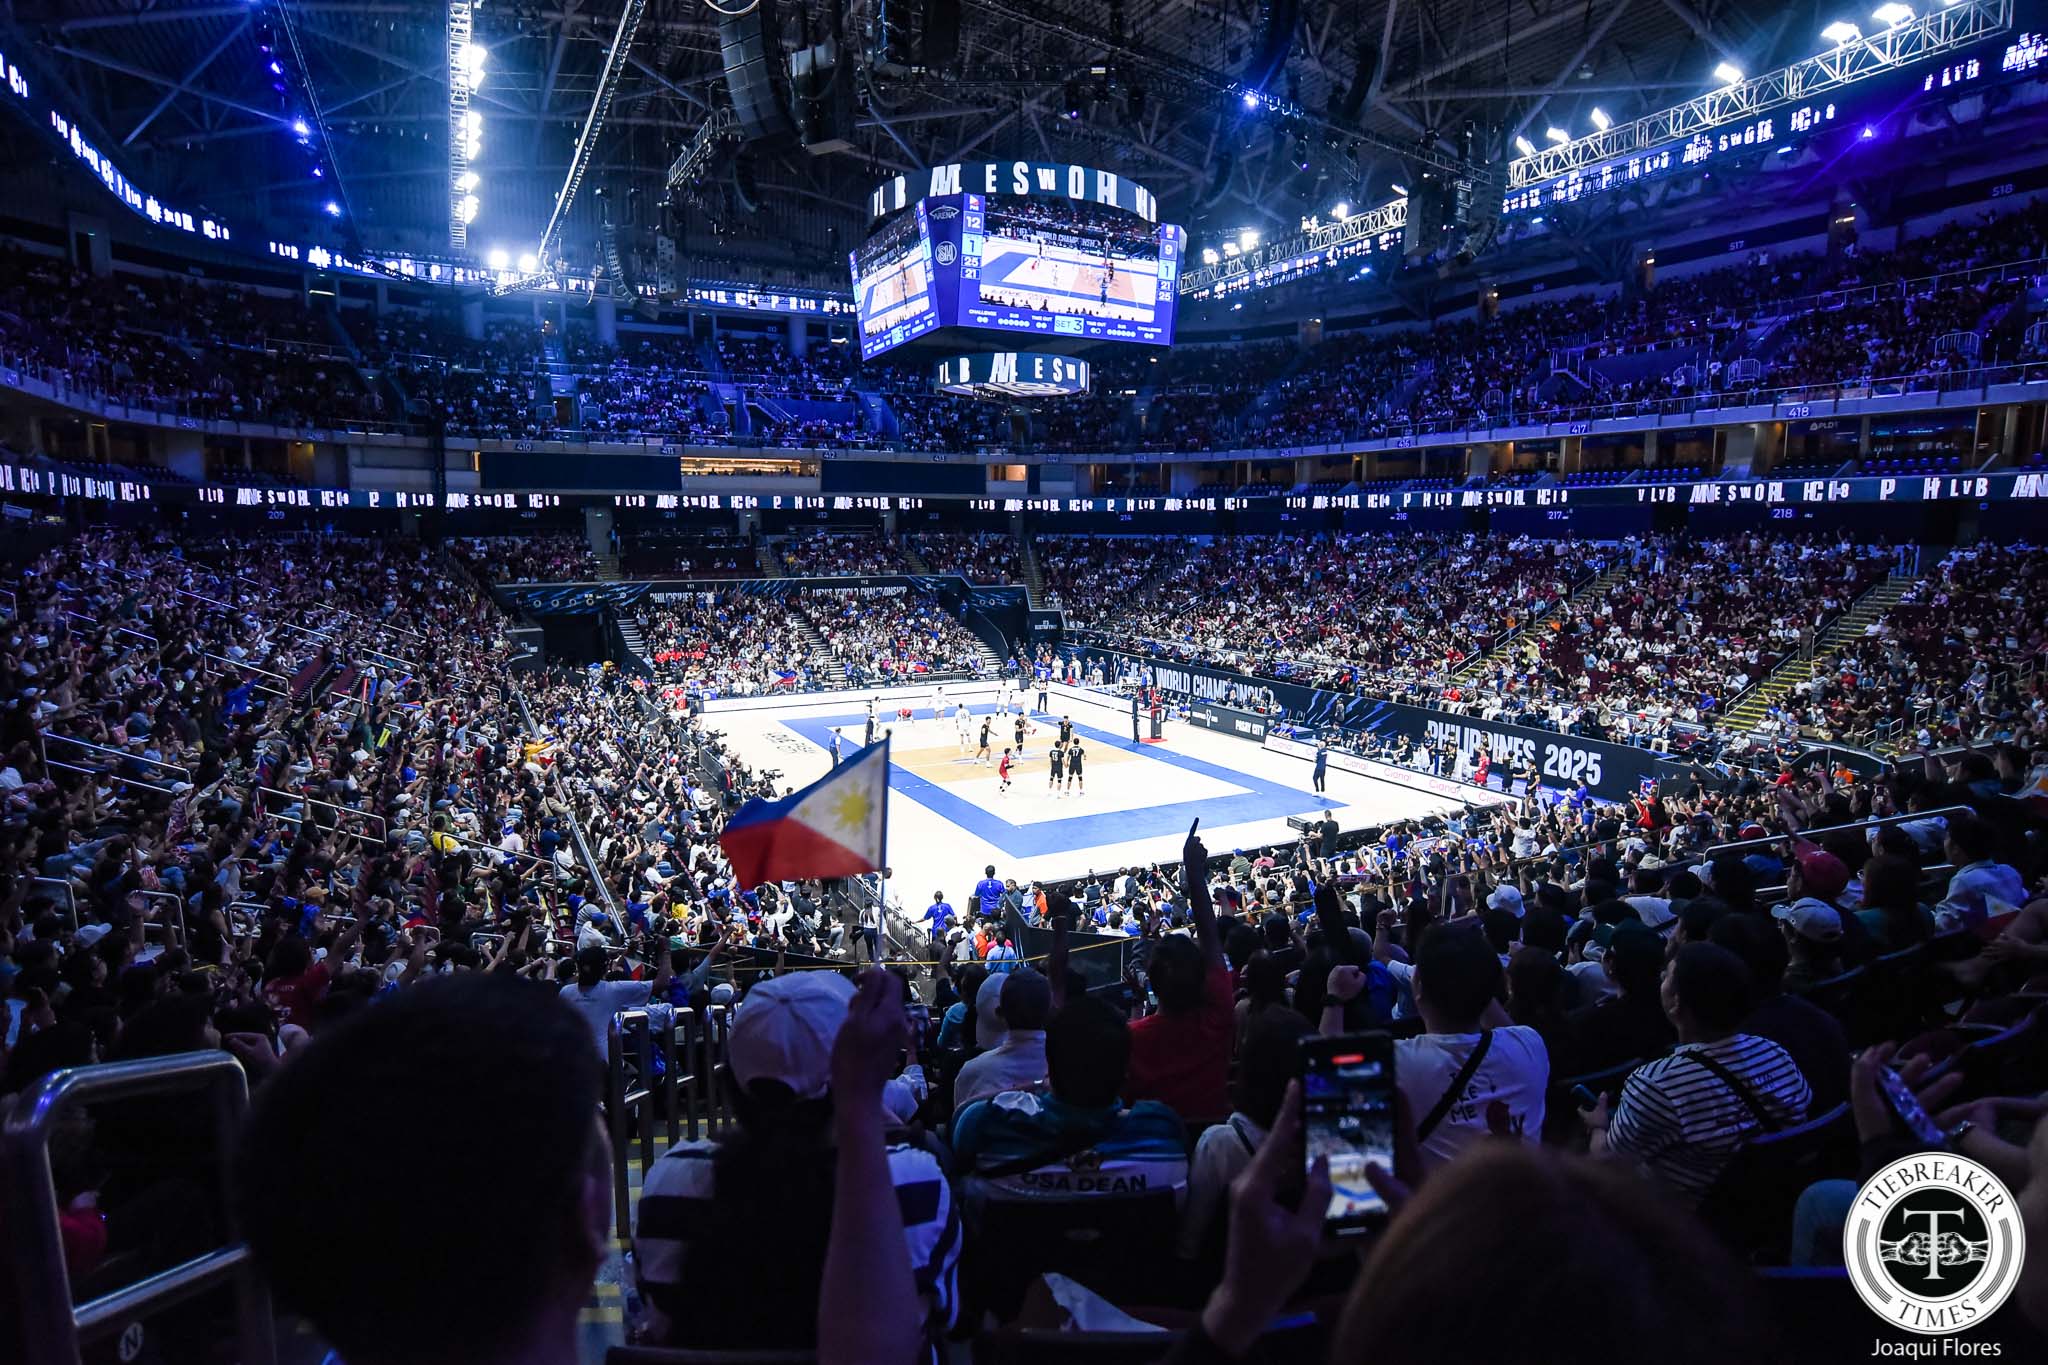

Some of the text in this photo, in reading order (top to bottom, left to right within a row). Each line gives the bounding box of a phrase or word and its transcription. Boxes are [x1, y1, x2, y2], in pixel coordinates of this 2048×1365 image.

[966, 216, 981, 229] 12
[1165, 244, 1173, 255] 9
[964, 256, 979, 267] 25
[964, 269, 978, 279] 21
[1158, 291, 1172, 301] 25
[1055, 319, 1071, 329] SET
[1073, 319, 1083, 331] 3
[1788, 407, 1809, 417] 418
[1571, 425, 1586, 434] 417
[1548, 511, 1562, 520] 217
[1773, 509, 1793, 519] 218
[1156, 667, 1190, 694] WORLD
[1544, 743, 1602, 786] 2025
[1077, 1174, 1147, 1192] DEAN
